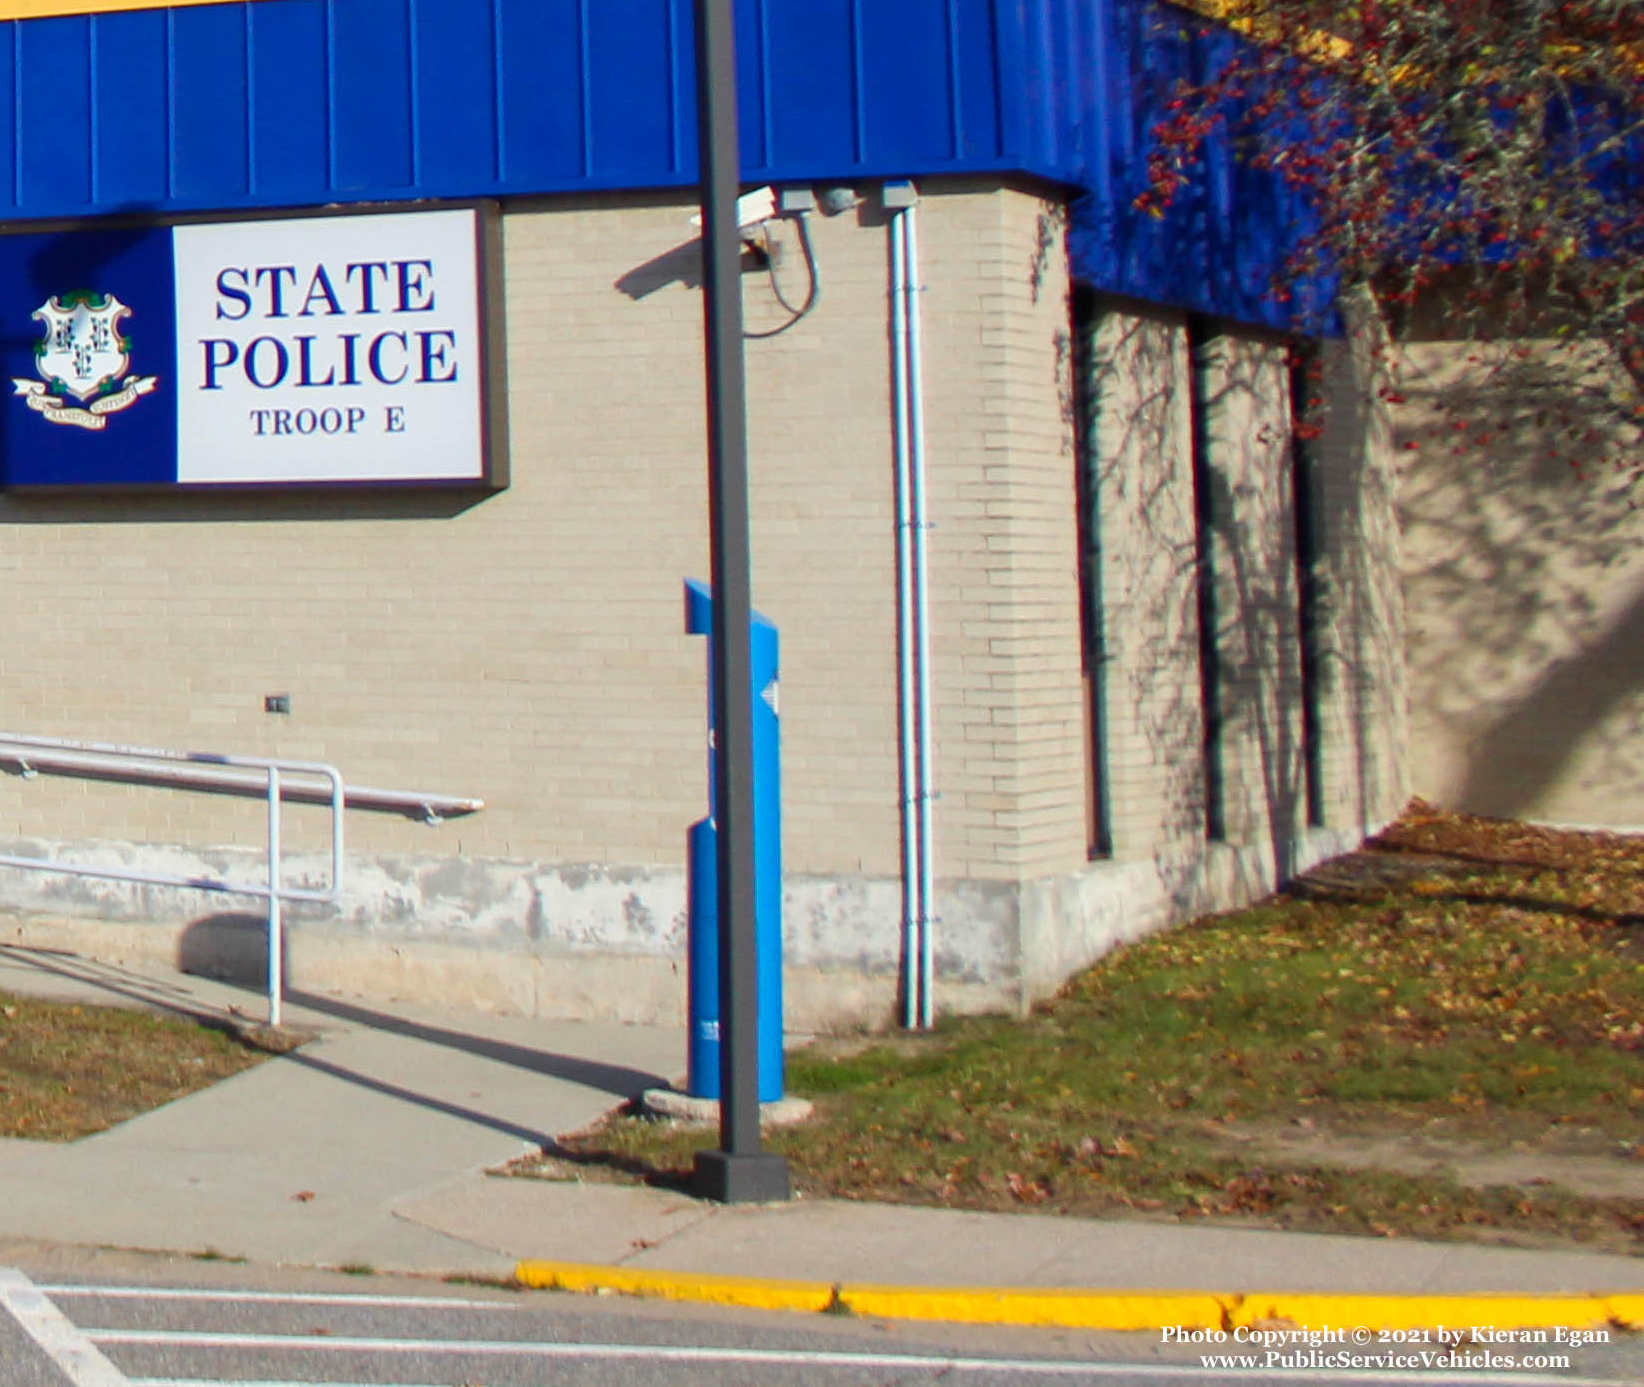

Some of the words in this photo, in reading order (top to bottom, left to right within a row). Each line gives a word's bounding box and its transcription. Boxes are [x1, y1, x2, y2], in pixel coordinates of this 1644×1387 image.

[215, 259, 436, 321] STATE
[197, 328, 458, 391] POLICE
[249, 407, 366, 436] TROOP
[383, 406, 406, 433] E
